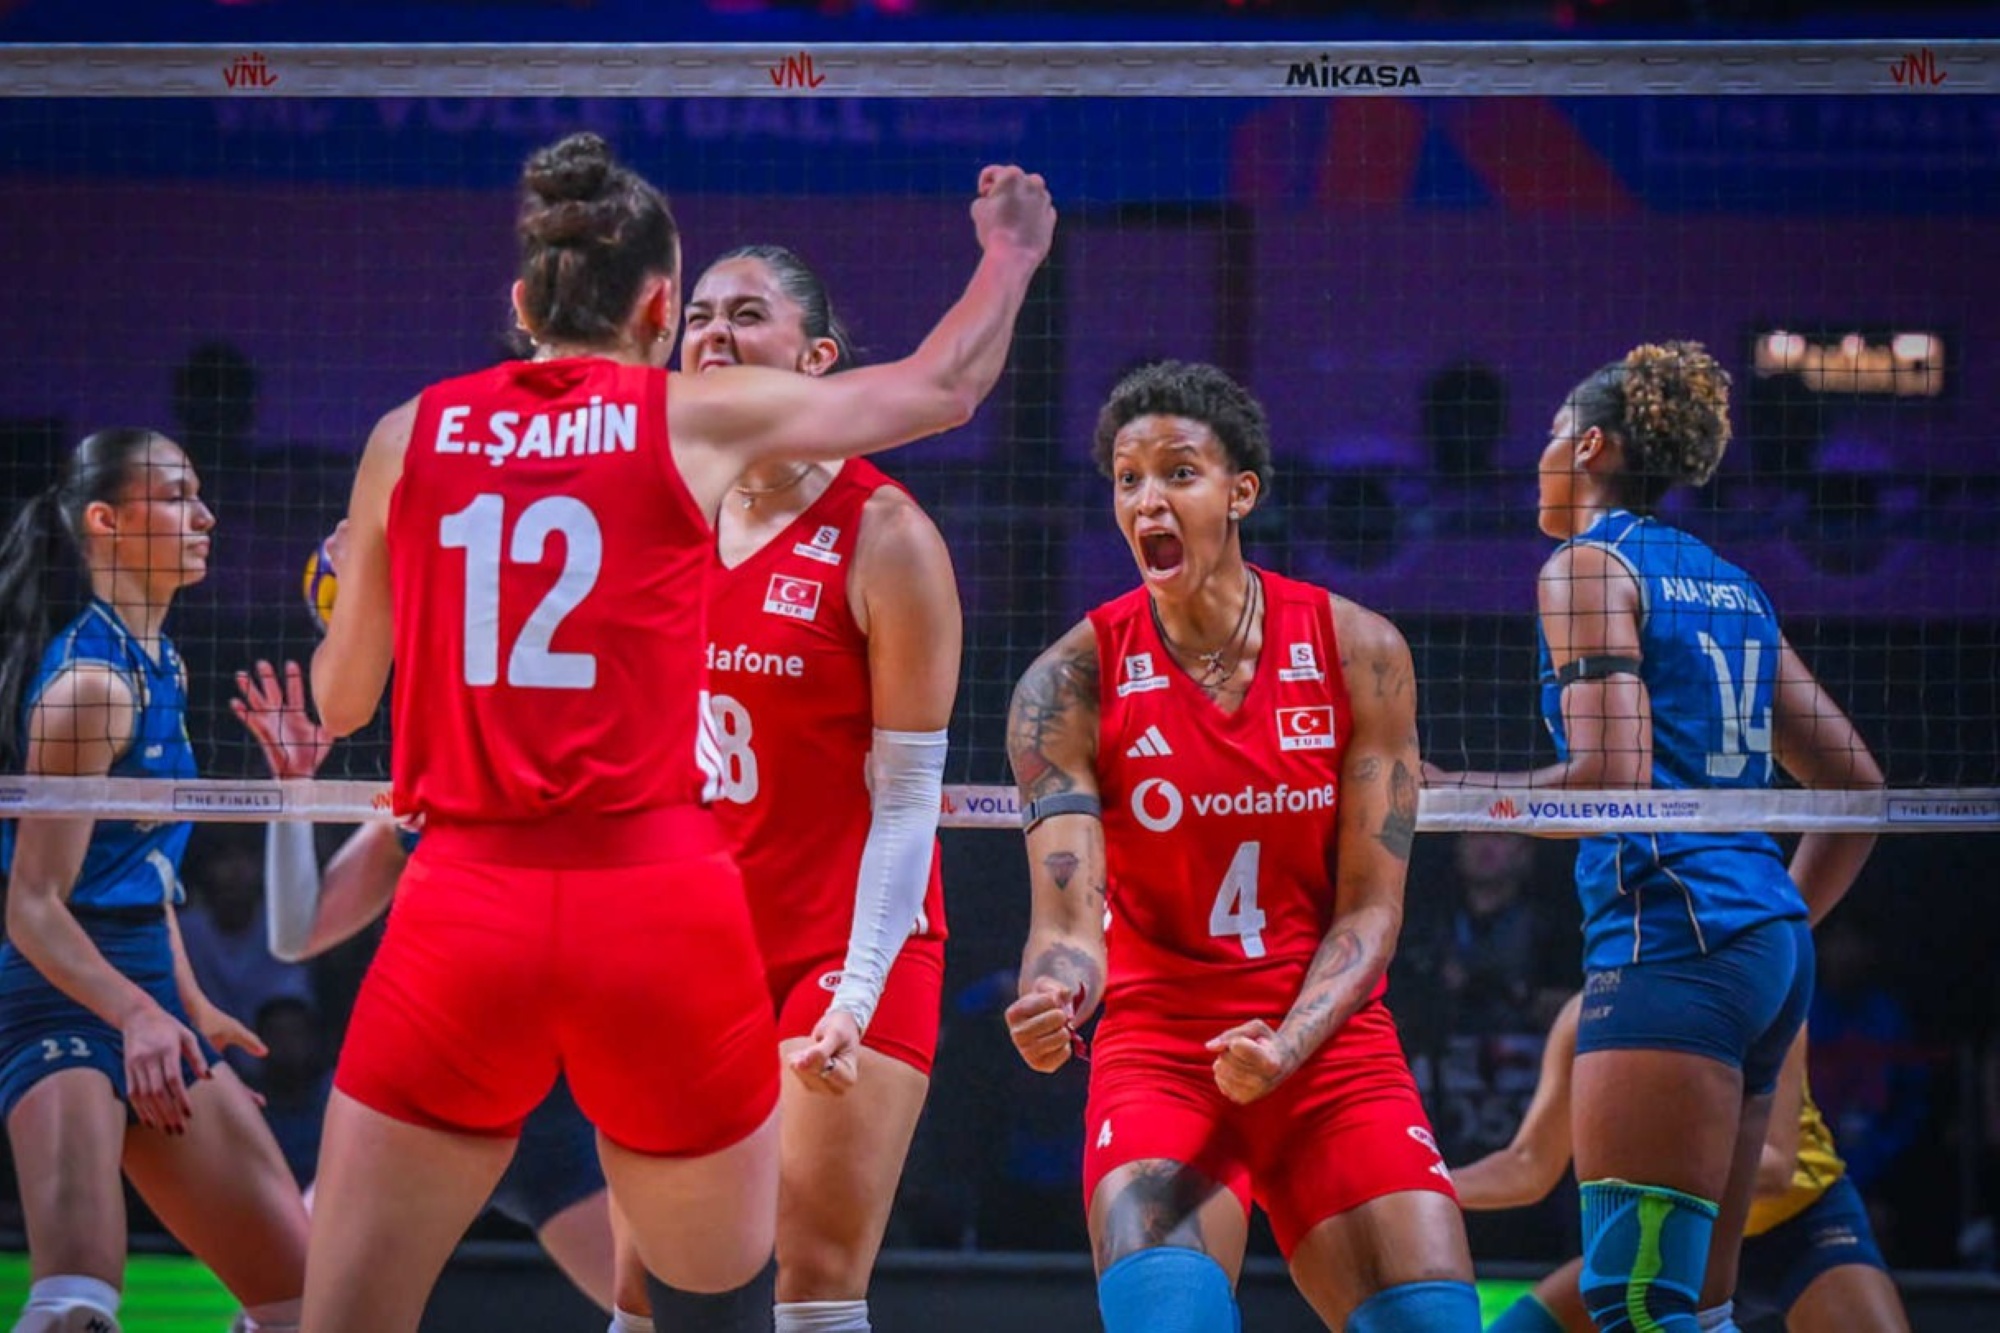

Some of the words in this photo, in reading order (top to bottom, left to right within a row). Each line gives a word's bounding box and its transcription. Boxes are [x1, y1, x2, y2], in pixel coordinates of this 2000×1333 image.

[434, 396, 638, 466] E.ŞAHİN
[439, 493, 602, 689] 12
[776, 603, 803, 616] TUR
[1697, 631, 1772, 783] 14
[1294, 736, 1323, 747] TUR
[187, 795, 211, 806] THE
[219, 795, 272, 807] FINALS
[371, 790, 393, 810] VN
[965, 796, 1022, 814] VOLL
[1190, 783, 1335, 816] vodafone
[1489, 797, 1521, 820] VNL
[1528, 802, 1658, 819] VOLLEYBALL
[1901, 805, 1928, 817] THE
[1209, 841, 1266, 958] 4
[1096, 1118, 1113, 1150] 4
